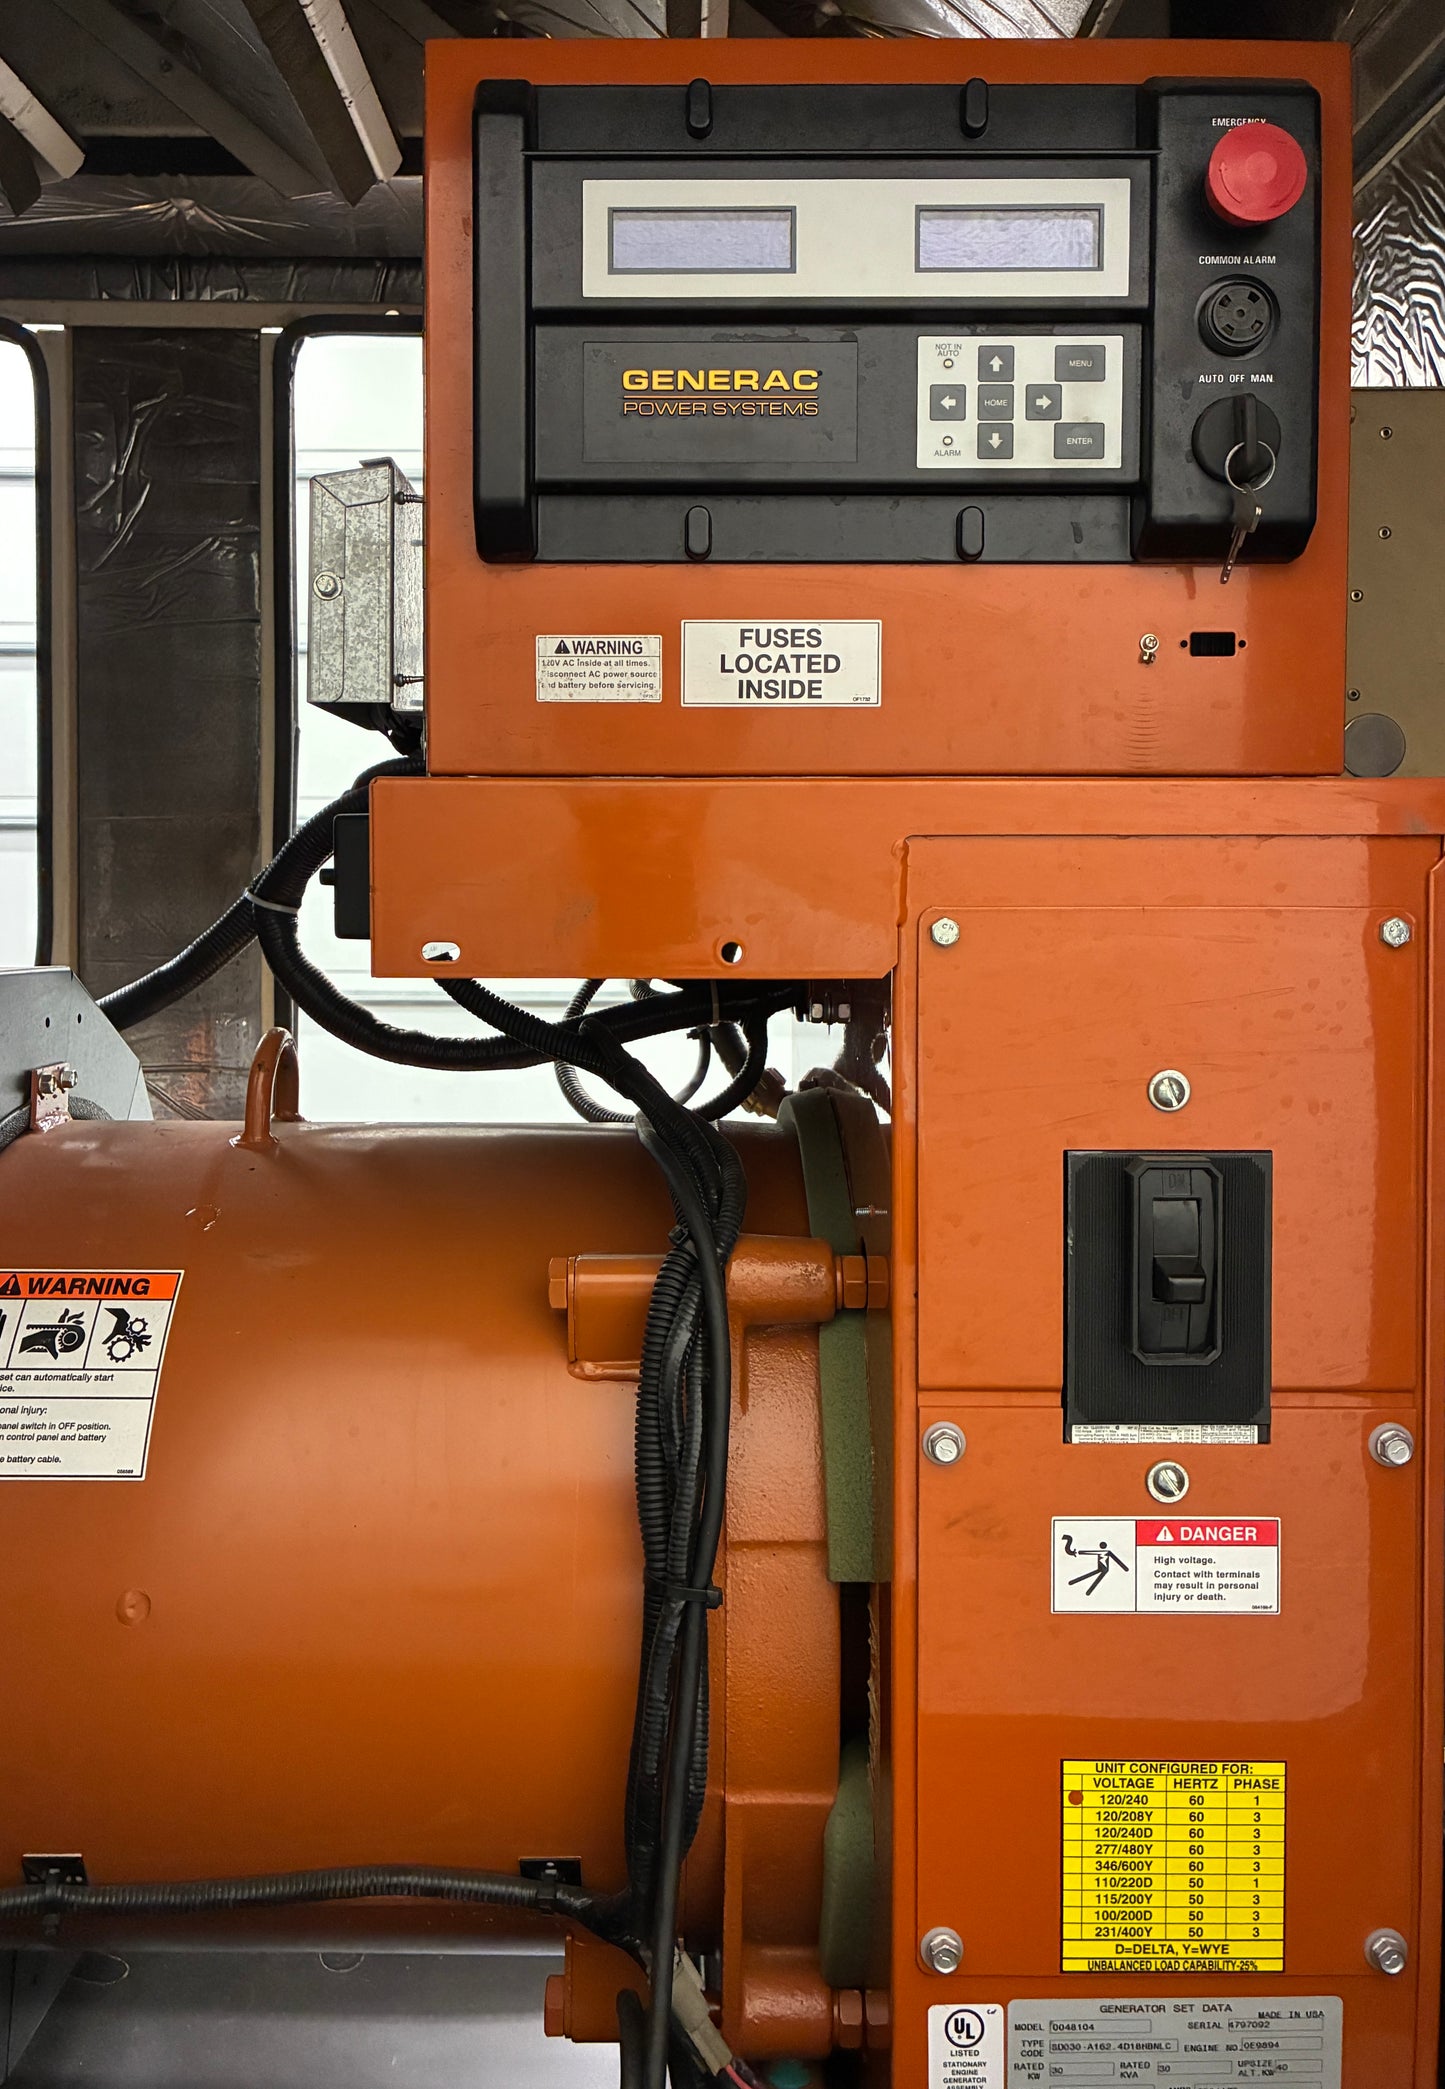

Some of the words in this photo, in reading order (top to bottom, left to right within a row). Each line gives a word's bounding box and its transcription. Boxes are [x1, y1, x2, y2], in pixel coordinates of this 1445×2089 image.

[1198, 255, 1241, 264] COMMON
[1243, 255, 1276, 264] ALARM
[935, 343, 952, 351] NOT
[954, 343, 962, 351] IN
[622, 369, 819, 391] GENERAC
[1198, 374, 1224, 383] AUTO
[1229, 374, 1245, 383] OFF
[1250, 374, 1274, 383] MAN
[984, 399, 1008, 407] HOME
[623, 402, 707, 416] POWER
[713, 402, 819, 416] SYSTEMS
[934, 449, 961, 457] ALARM
[740, 628, 823, 648] FUSES
[572, 640, 643, 655] WARNING
[577, 659, 602, 667] inside
[626, 659, 651, 667] times.
[720, 654, 841, 674] LOCATED
[541, 670, 586, 678] isconnect
[603, 671, 628, 679] power
[558, 682, 587, 691] battery
[617, 681, 657, 690] servicing.
[738, 679, 823, 699] INSIDE
[28, 1277, 150, 1296] WARNING
[33, 1374, 92, 1383] automatically
[20, 1406, 48, 1416] injury:
[20, 1423, 47, 1431] switch
[77, 1423, 111, 1432] position.
[36, 1434, 59, 1443] panel
[78, 1434, 107, 1443] battery
[7, 1456, 36, 1464] battery
[1180, 1526, 1257, 1541] DANGER
[1154, 1556, 1176, 1565] High
[1178, 1556, 1216, 1565] voltage.
[1154, 1570, 1191, 1579] Contact
[1193, 1570, 1214, 1579] with
[1216, 1570, 1261, 1579] terminals
[1154, 1583, 1174, 1591] may
[1176, 1581, 1203, 1590] result
[1206, 1582, 1216, 1590] in
[1218, 1582, 1259, 1591] personal
[1154, 1593, 1181, 1602] injury
[1197, 1593, 1227, 1601] death.
[1095, 1763, 1126, 1774] UNIT
[1129, 1763, 1218, 1774] CONFIGURED
[1222, 1764, 1254, 1774] FOR:
[1093, 1778, 1155, 1789] VOLTAGE
[1173, 1779, 1219, 1790] HERTZ
[1234, 1779, 1280, 1790] PHASE
[1100, 1795, 1149, 1806] 120/240
[1188, 1796, 1204, 1806] 60
[1253, 1796, 1260, 1806] 1
[1096, 1811, 1153, 1822] 120/208Y
[1188, 1812, 1204, 1822] 60
[1253, 1812, 1261, 1822] 3
[1095, 1828, 1153, 1838] 120/240D
[1188, 1828, 1204, 1838] 60
[1253, 1828, 1261, 1838] 3
[1095, 1844, 1153, 1854] 277/480Y
[1188, 1844, 1204, 1855] 60
[1253, 1845, 1261, 1855] 3
[1095, 1861, 1153, 1872] 346/600Y
[1188, 1862, 1204, 1872] 60
[1253, 1862, 1261, 1872] 3
[1095, 1877, 1153, 1888] 110/220D
[1188, 1878, 1204, 1888] 50
[1253, 1878, 1260, 1888] 1
[1096, 1894, 1153, 1904] 115/200Y
[1188, 1894, 1204, 1905] 50
[1253, 1895, 1261, 1905] 3
[1095, 1910, 1152, 1921] 100/200D
[1188, 1911, 1204, 1921] 50
[1253, 1911, 1261, 1921] 3
[1095, 1927, 1152, 1938] 231/400Y
[1188, 1928, 1204, 1938] 50
[1253, 1928, 1261, 1938] 3
[1115, 1944, 1179, 1955] D=DELTA,
[1182, 1944, 1230, 1955] Y=WYE
[1087, 1961, 1152, 1971] UNBALANCED
[1154, 1961, 1181, 1971] LOAD
[1182, 1961, 1258, 1971] CAPABILITY-25%
[1100, 2004, 1166, 2013] GENERATOR
[1173, 2004, 1195, 2013] SET
[1202, 2003, 1233, 2013] DATA
[1258, 2011, 1282, 2019] MADE
[1289, 2011, 1301, 2019] IN
[1306, 2010, 1325, 2018] USA
[954, 2018, 976, 2039] UL
[1014, 2023, 1045, 2031] MODEL
[1052, 2023, 1095, 2031] 0048104
[1187, 2022, 1223, 2030] SERIAL
[1022, 2040, 1044, 2048] TYPE
[1184, 2044, 1219, 2052] ENGINE
[1226, 2043, 1243, 2052] NO.
[1014, 2063, 1045, 2071] RATED
[1120, 2062, 1150, 2070] RATED
[1238, 2060, 1273, 2068] UPSIZE
[1051, 2066, 1063, 2074] 30
[1120, 2071, 1139, 2079] KVA
[1158, 2065, 1171, 2073] 30
